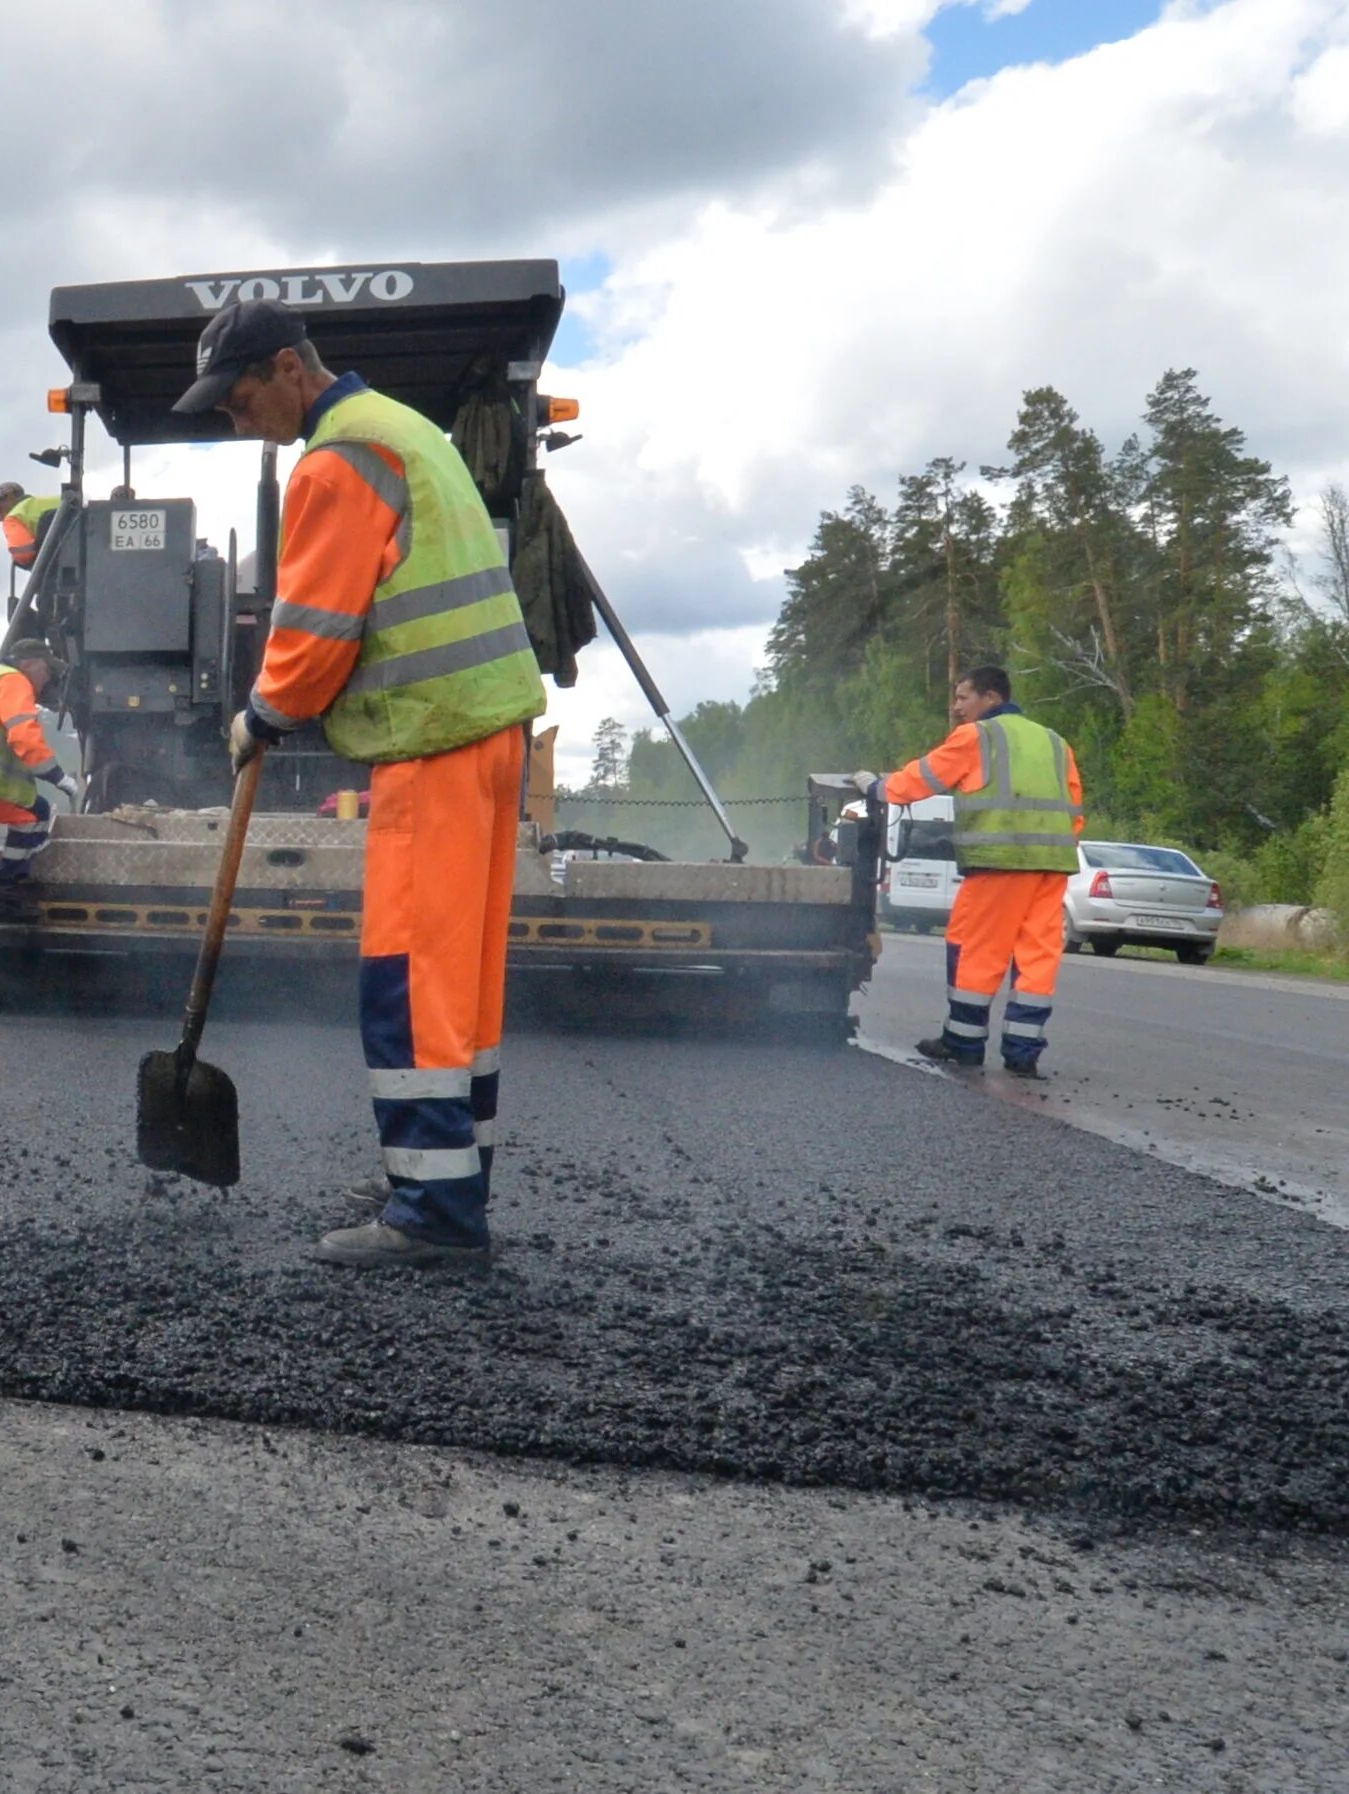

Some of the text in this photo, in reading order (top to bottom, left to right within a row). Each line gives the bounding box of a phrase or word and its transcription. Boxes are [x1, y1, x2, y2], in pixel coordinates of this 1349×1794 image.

[185, 270, 414, 309] VOLVO
[118, 513, 159, 529] 6580
[144, 535, 161, 547] 66
